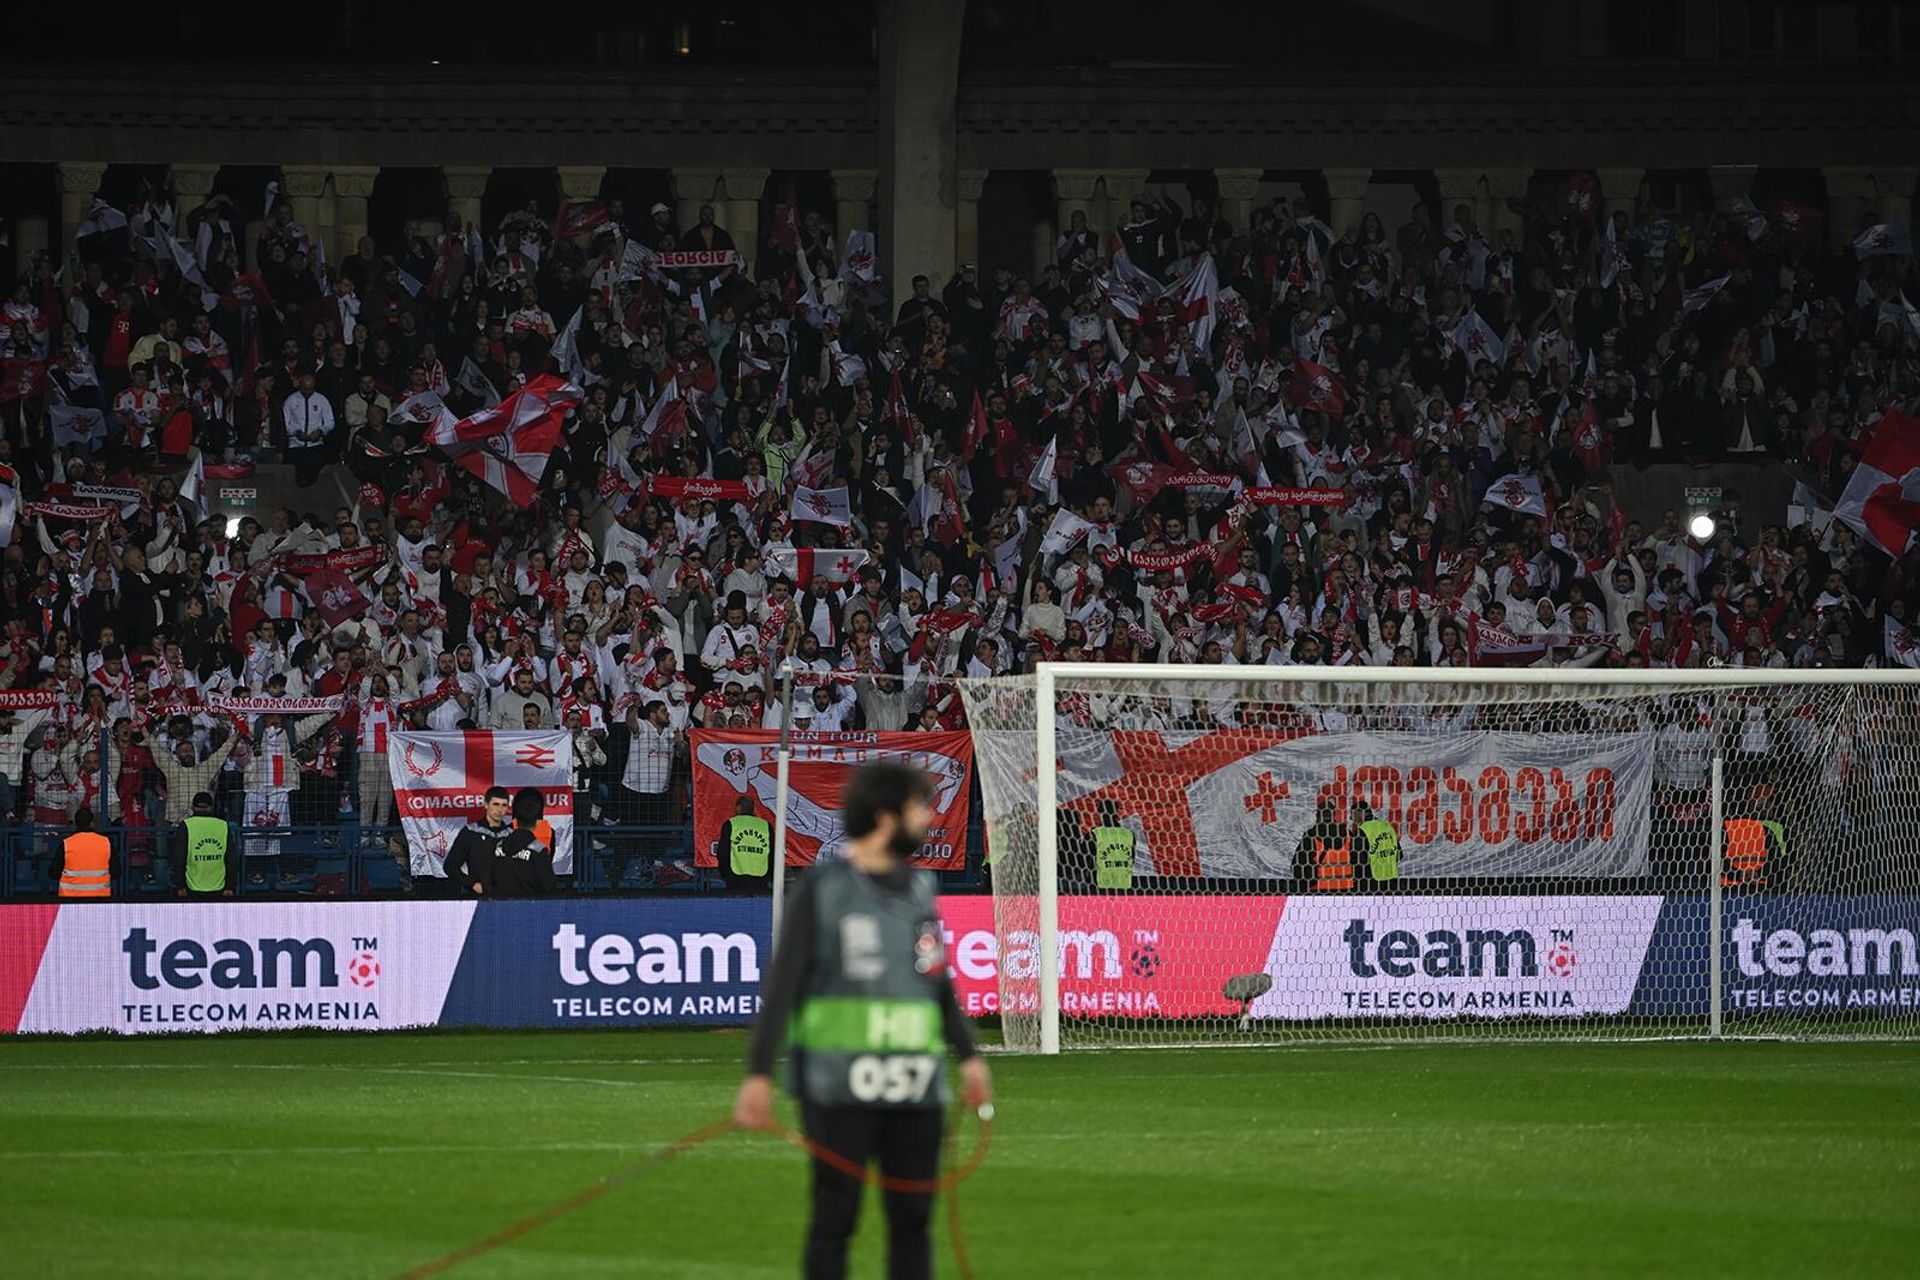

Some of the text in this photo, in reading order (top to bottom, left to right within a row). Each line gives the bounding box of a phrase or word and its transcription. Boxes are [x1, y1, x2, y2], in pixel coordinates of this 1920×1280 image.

[407, 795, 485, 810] OMAGEB
[552, 923, 760, 986] team
[1344, 919, 1536, 978] team
[1732, 918, 1920, 976] team
[122, 927, 377, 990] team TM
[553, 995, 765, 1017] TELECOM ARME
[966, 992, 1160, 1011] ECOM RMENIA
[1344, 991, 1575, 1009] TELECOM ARMENIA
[1732, 988, 1920, 1007] TELECOM ARME
[122, 1002, 380, 1023] TELECOM ARMENIA
[849, 1053, 937, 1102] 057
